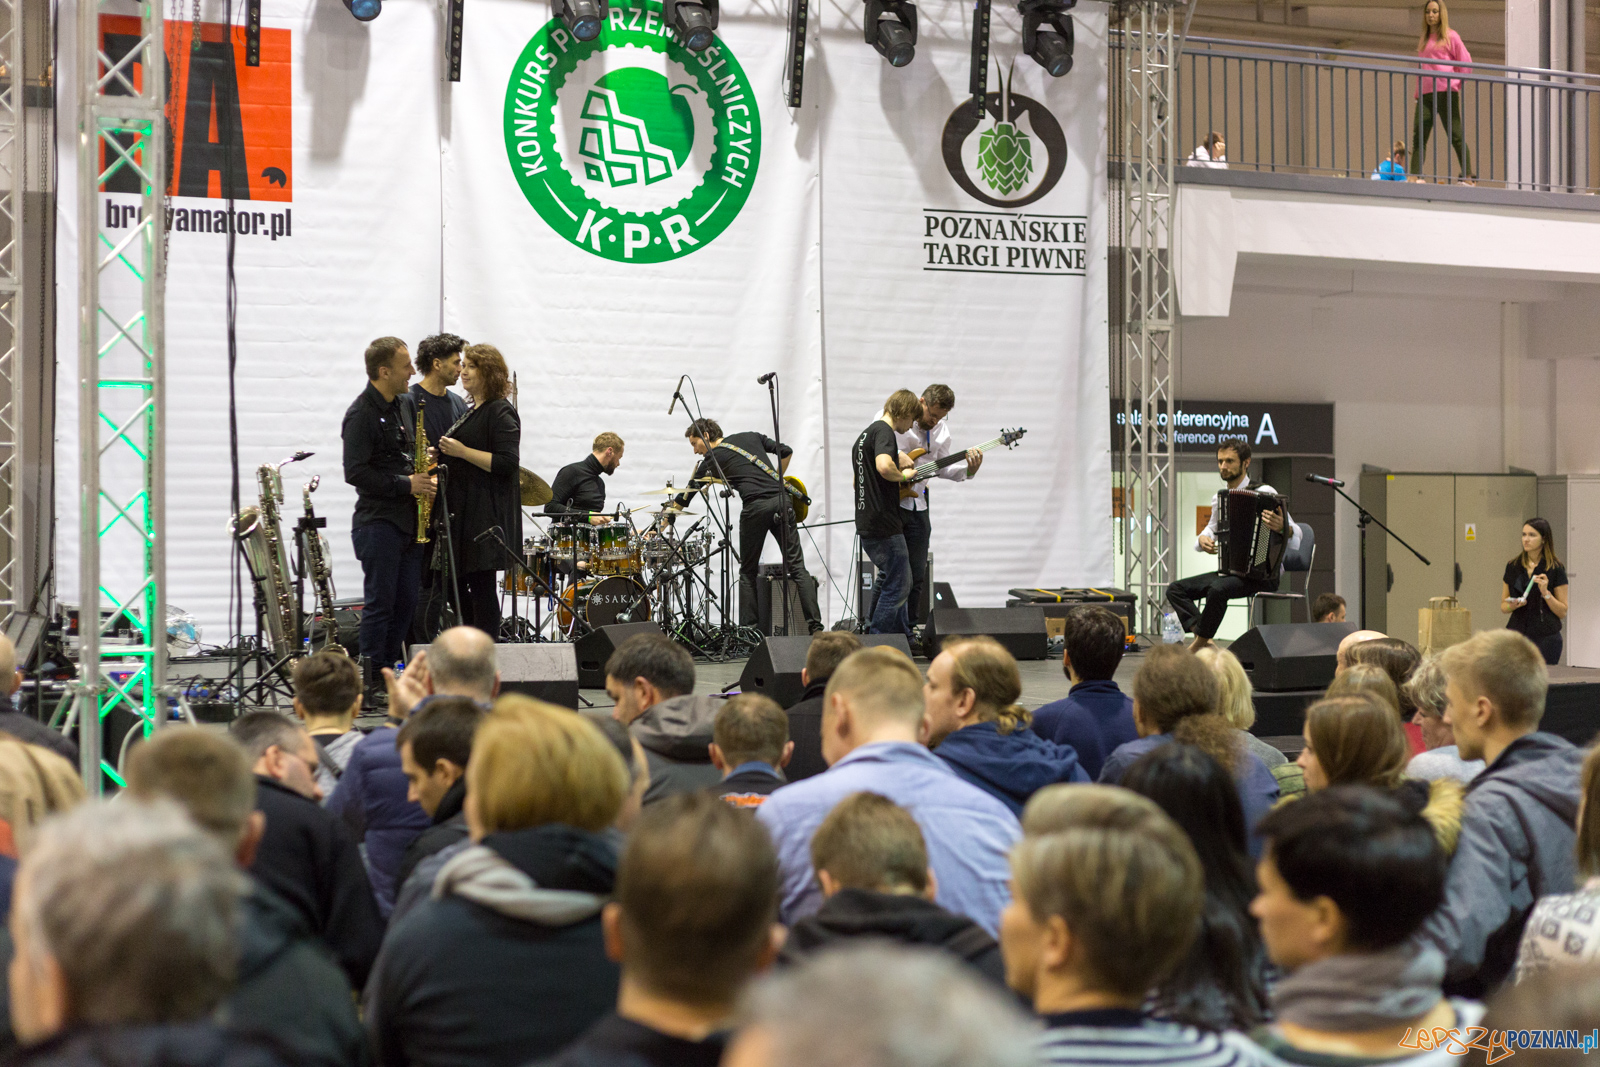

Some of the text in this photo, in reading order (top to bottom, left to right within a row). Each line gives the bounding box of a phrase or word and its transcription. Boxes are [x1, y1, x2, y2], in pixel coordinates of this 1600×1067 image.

[514, 44, 558, 177] KONKURS
[924, 214, 1086, 243] POZNAŃSKIE
[923, 243, 1086, 269] TARGI PIWNE
[1255, 413, 1278, 445] A
[605, 595, 640, 603] SAKA
